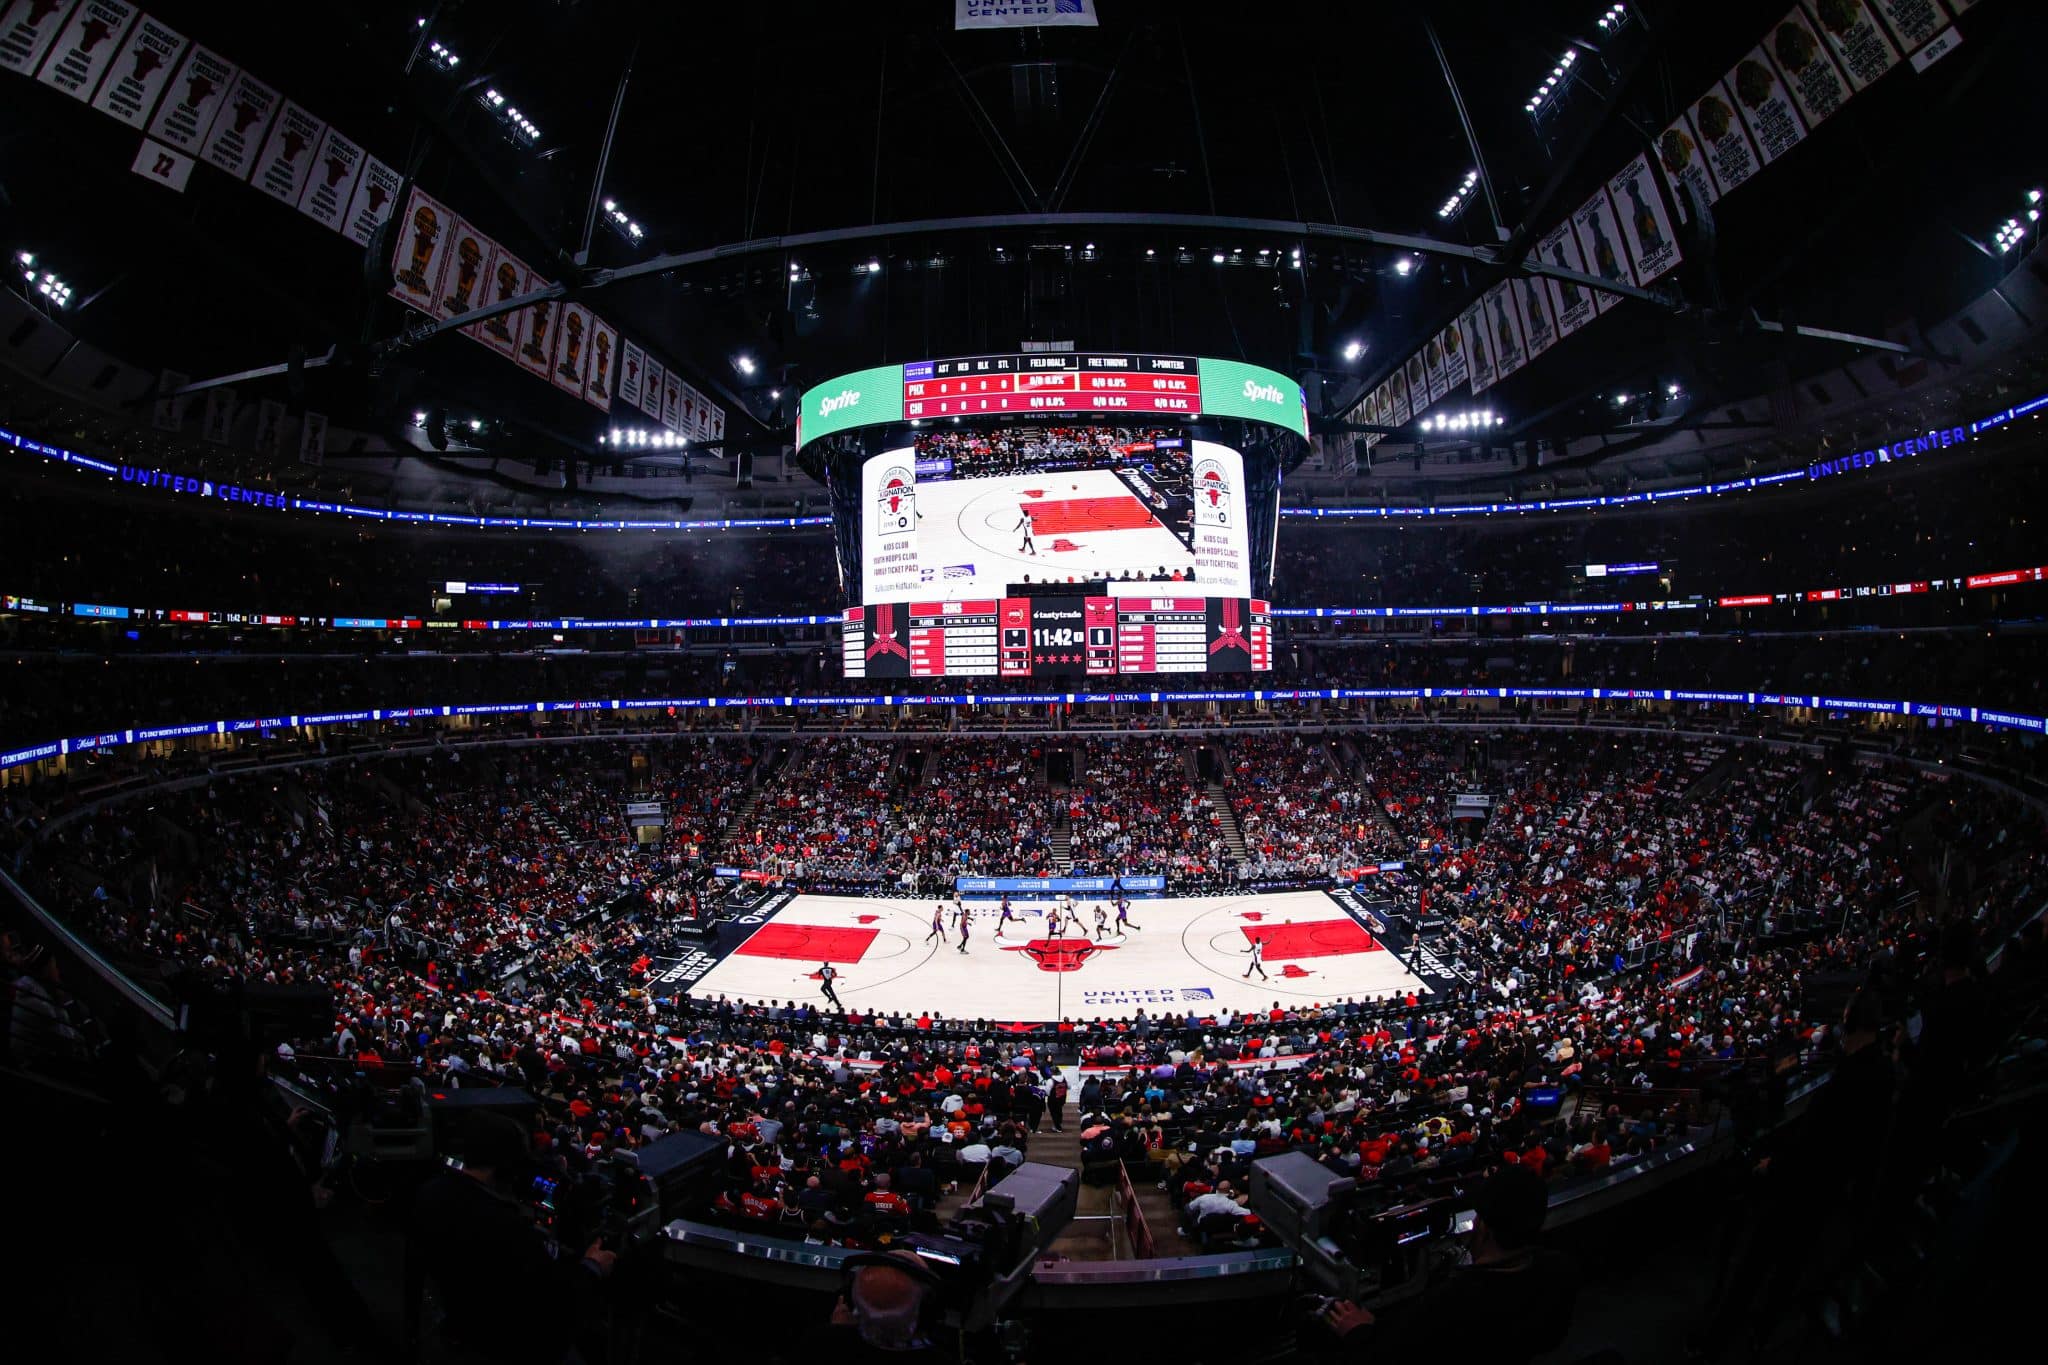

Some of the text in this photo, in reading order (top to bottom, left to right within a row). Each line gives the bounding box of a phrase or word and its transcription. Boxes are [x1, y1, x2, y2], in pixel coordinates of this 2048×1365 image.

[968, 7, 1049, 16] CENTER
[144, 22, 179, 48] CHICAGO
[330, 134, 359, 159] CHICAGO
[370, 163, 398, 185] CHICAGO
[938, 364, 950, 373] AST
[978, 361, 989, 370] BLK
[998, 360, 1009, 368] STL
[1031, 359, 1046, 367] FIELD
[1088, 358, 1103, 367] FREE
[909, 383, 924, 396] PHX
[1243, 380, 1284, 405] Sprite
[819, 390, 860, 417] Sprite
[1808, 427, 1966, 480] UNITED CENTER
[122, 465, 287, 509] UNITED CENTER
[1151, 599, 1174, 611] BULLS
[1040, 611, 1082, 620] tastytrade
[1033, 628, 1073, 647] 11:42
[1097, 629, 1104, 645] 0
[1783, 696, 1803, 704] ULTRA
[1941, 707, 1962, 717] ULTRA
[260, 718, 282, 728] ULTRA
[99, 734, 118, 745] ULTRA
[660, 951, 708, 983] CHICAGO
[680, 957, 717, 982] BULLS
[1084, 989, 1173, 997] UNITED
[1085, 996, 1175, 1005] CENTER
